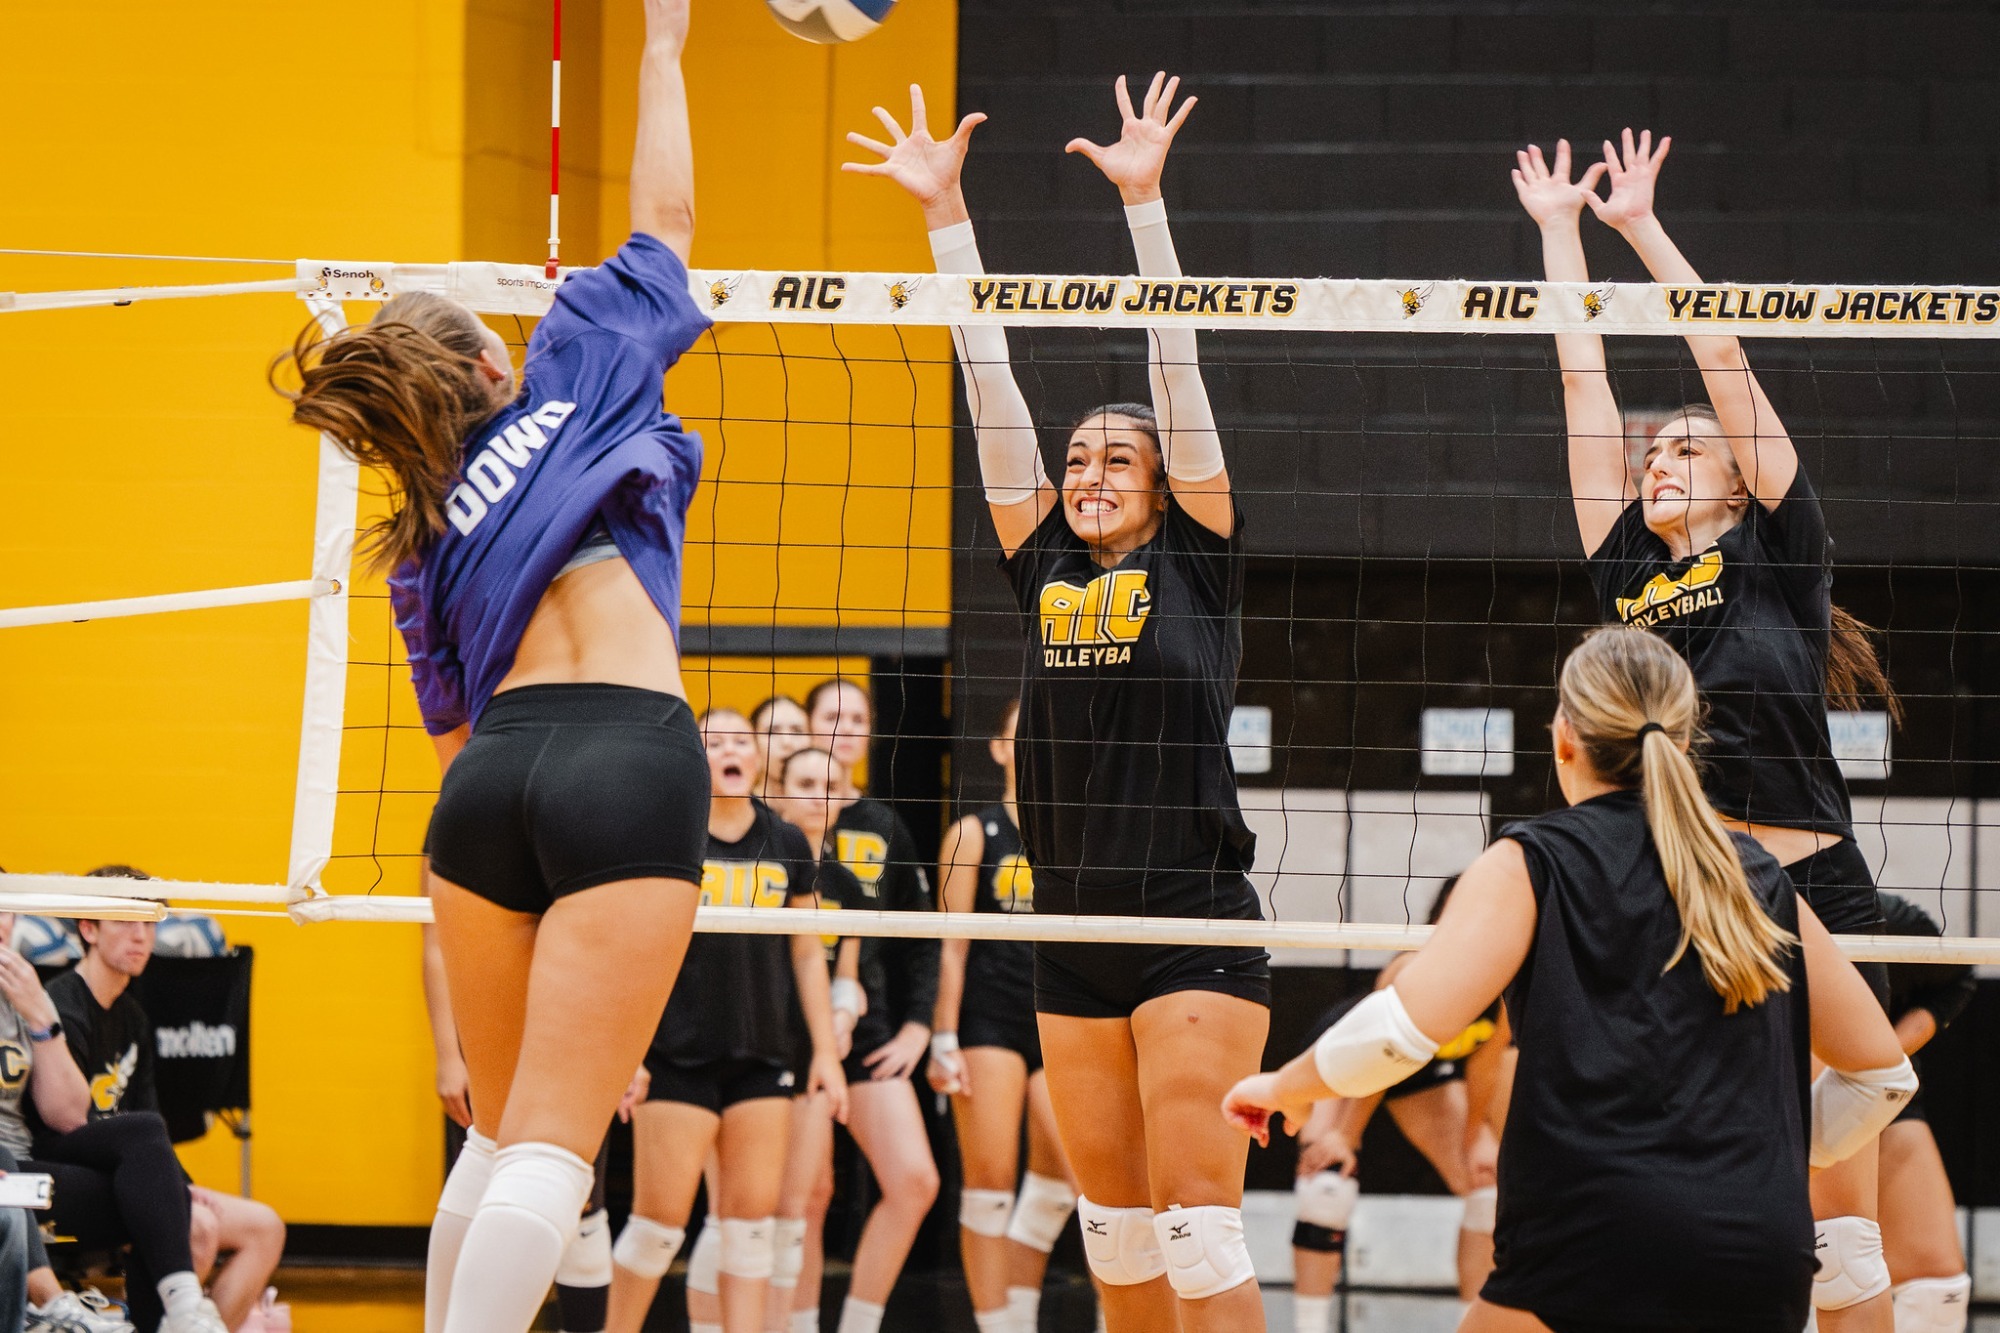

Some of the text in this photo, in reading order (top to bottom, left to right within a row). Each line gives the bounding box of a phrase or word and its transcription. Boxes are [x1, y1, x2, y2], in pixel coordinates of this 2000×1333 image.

[333, 269, 374, 279] Senoh
[497, 277, 524, 287] sports
[770, 276, 847, 312] AIC
[967, 278, 1300, 317] YELLOW JACKETS
[1462, 285, 1540, 321] AIC
[1664, 287, 2000, 325] YELLOW JACKETS
[445, 400, 577, 537] DOWD
[1040, 569, 1151, 645] AIC
[1043, 646, 1131, 668] OLLEYBA
[836, 829, 888, 884] IC
[701, 859, 789, 907] AIC
